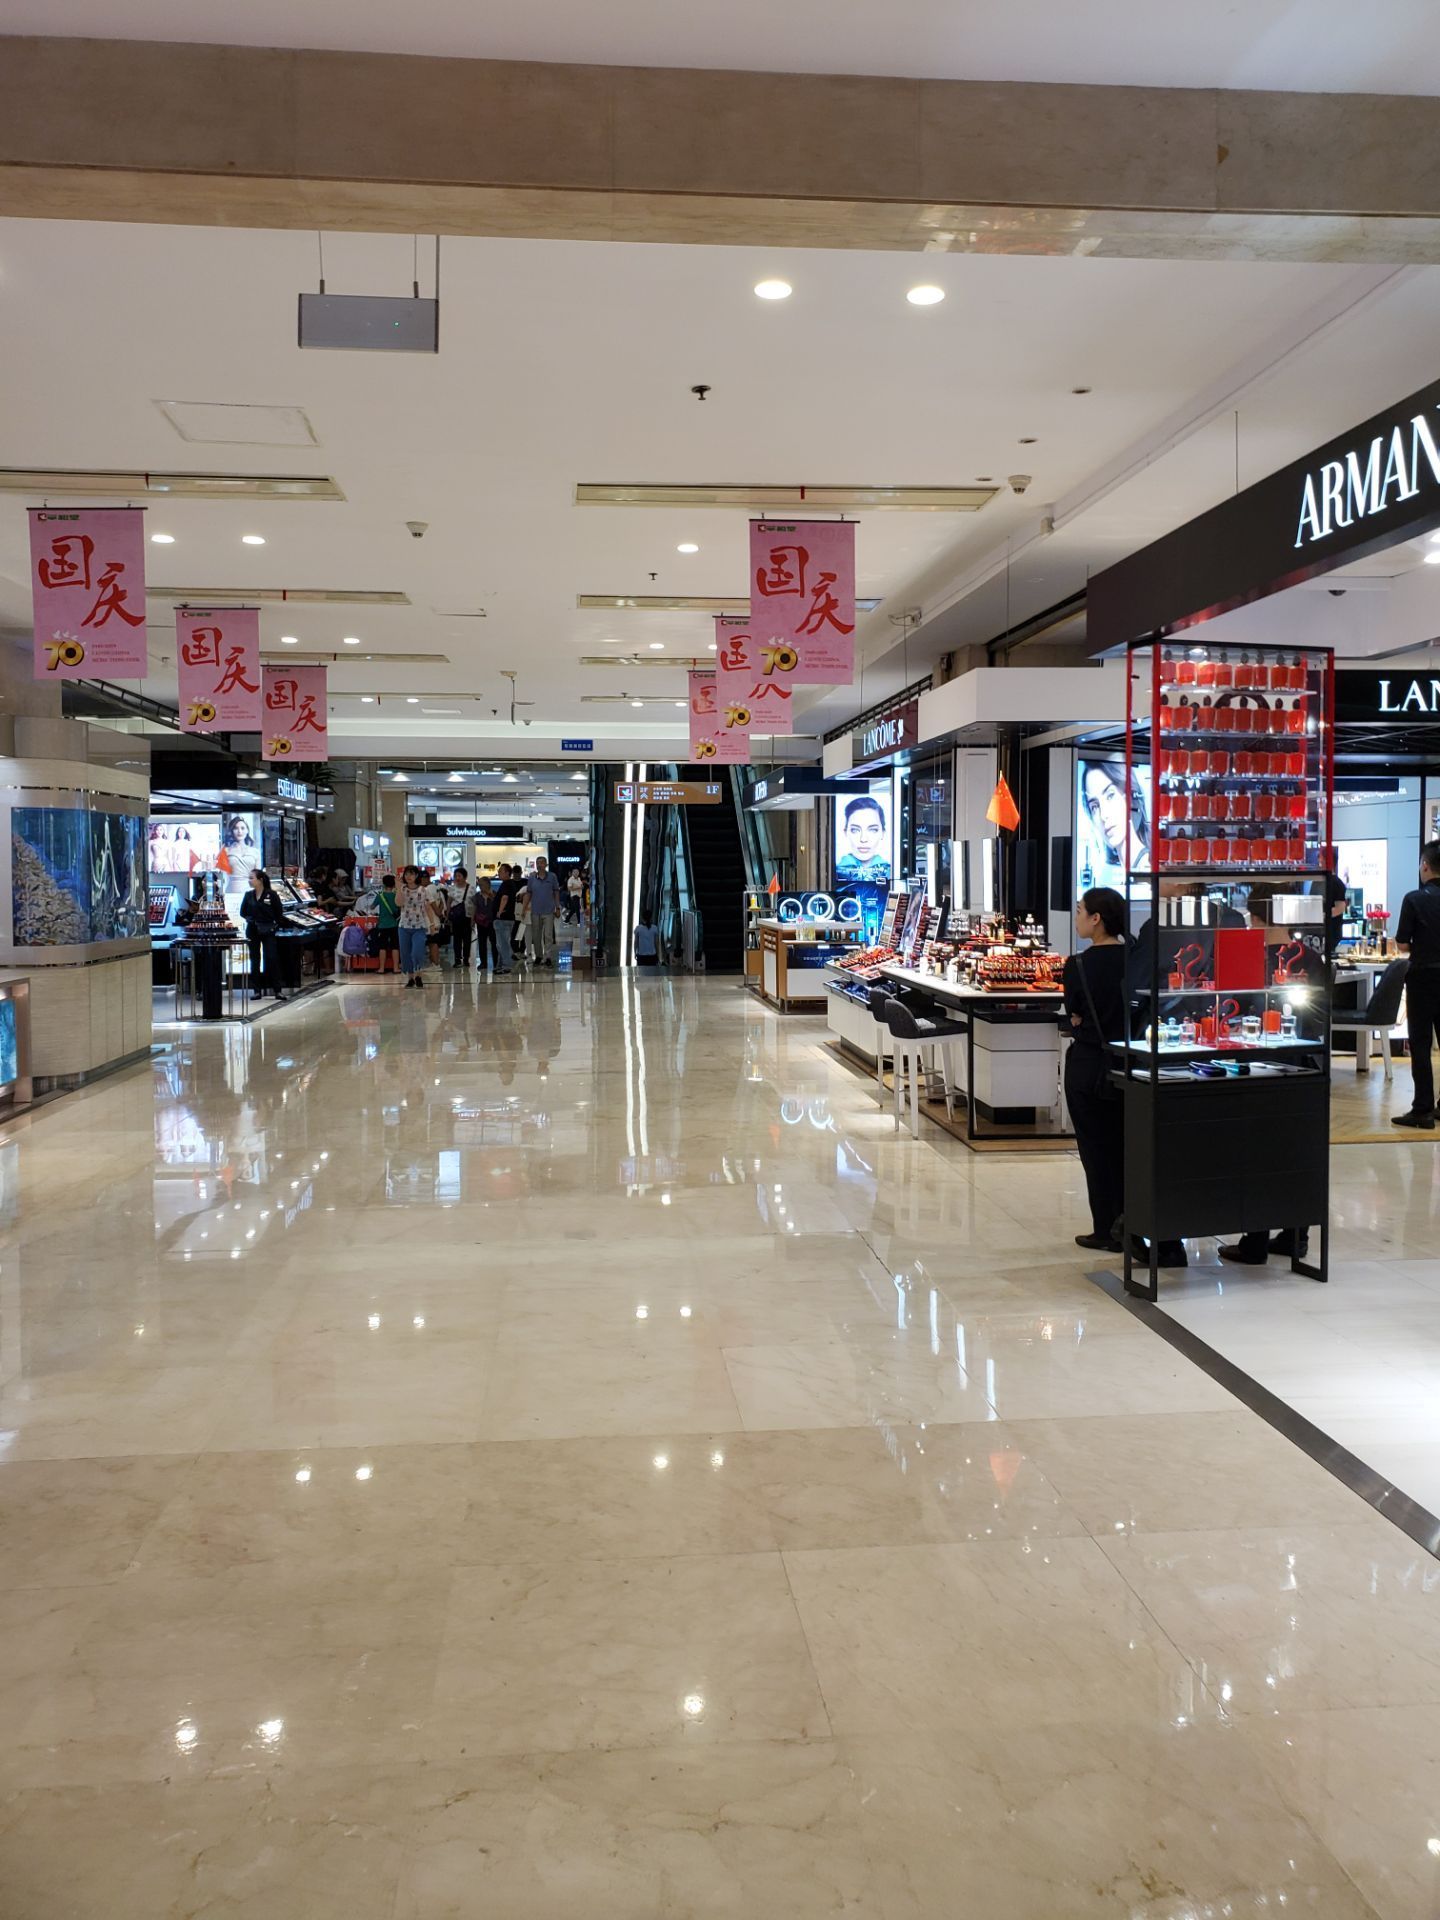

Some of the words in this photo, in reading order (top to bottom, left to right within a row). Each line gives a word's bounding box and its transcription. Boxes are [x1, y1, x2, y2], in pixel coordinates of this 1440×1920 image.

[38, 535, 145, 628] 国庆
[756, 545, 855, 635] 国庆
[43, 640, 84, 671] 70
[182, 627, 260, 694] 国庆
[759, 646, 798, 675] 70
[185, 703, 216, 725] 70
[266, 680, 326, 733] 国庆
[722, 706, 751, 728] 70
[267, 738, 292, 756] 70
[694, 742, 717, 759] 70
[706, 785, 720, 794] 1F
[446, 827, 486, 836] Sulwhasoo
